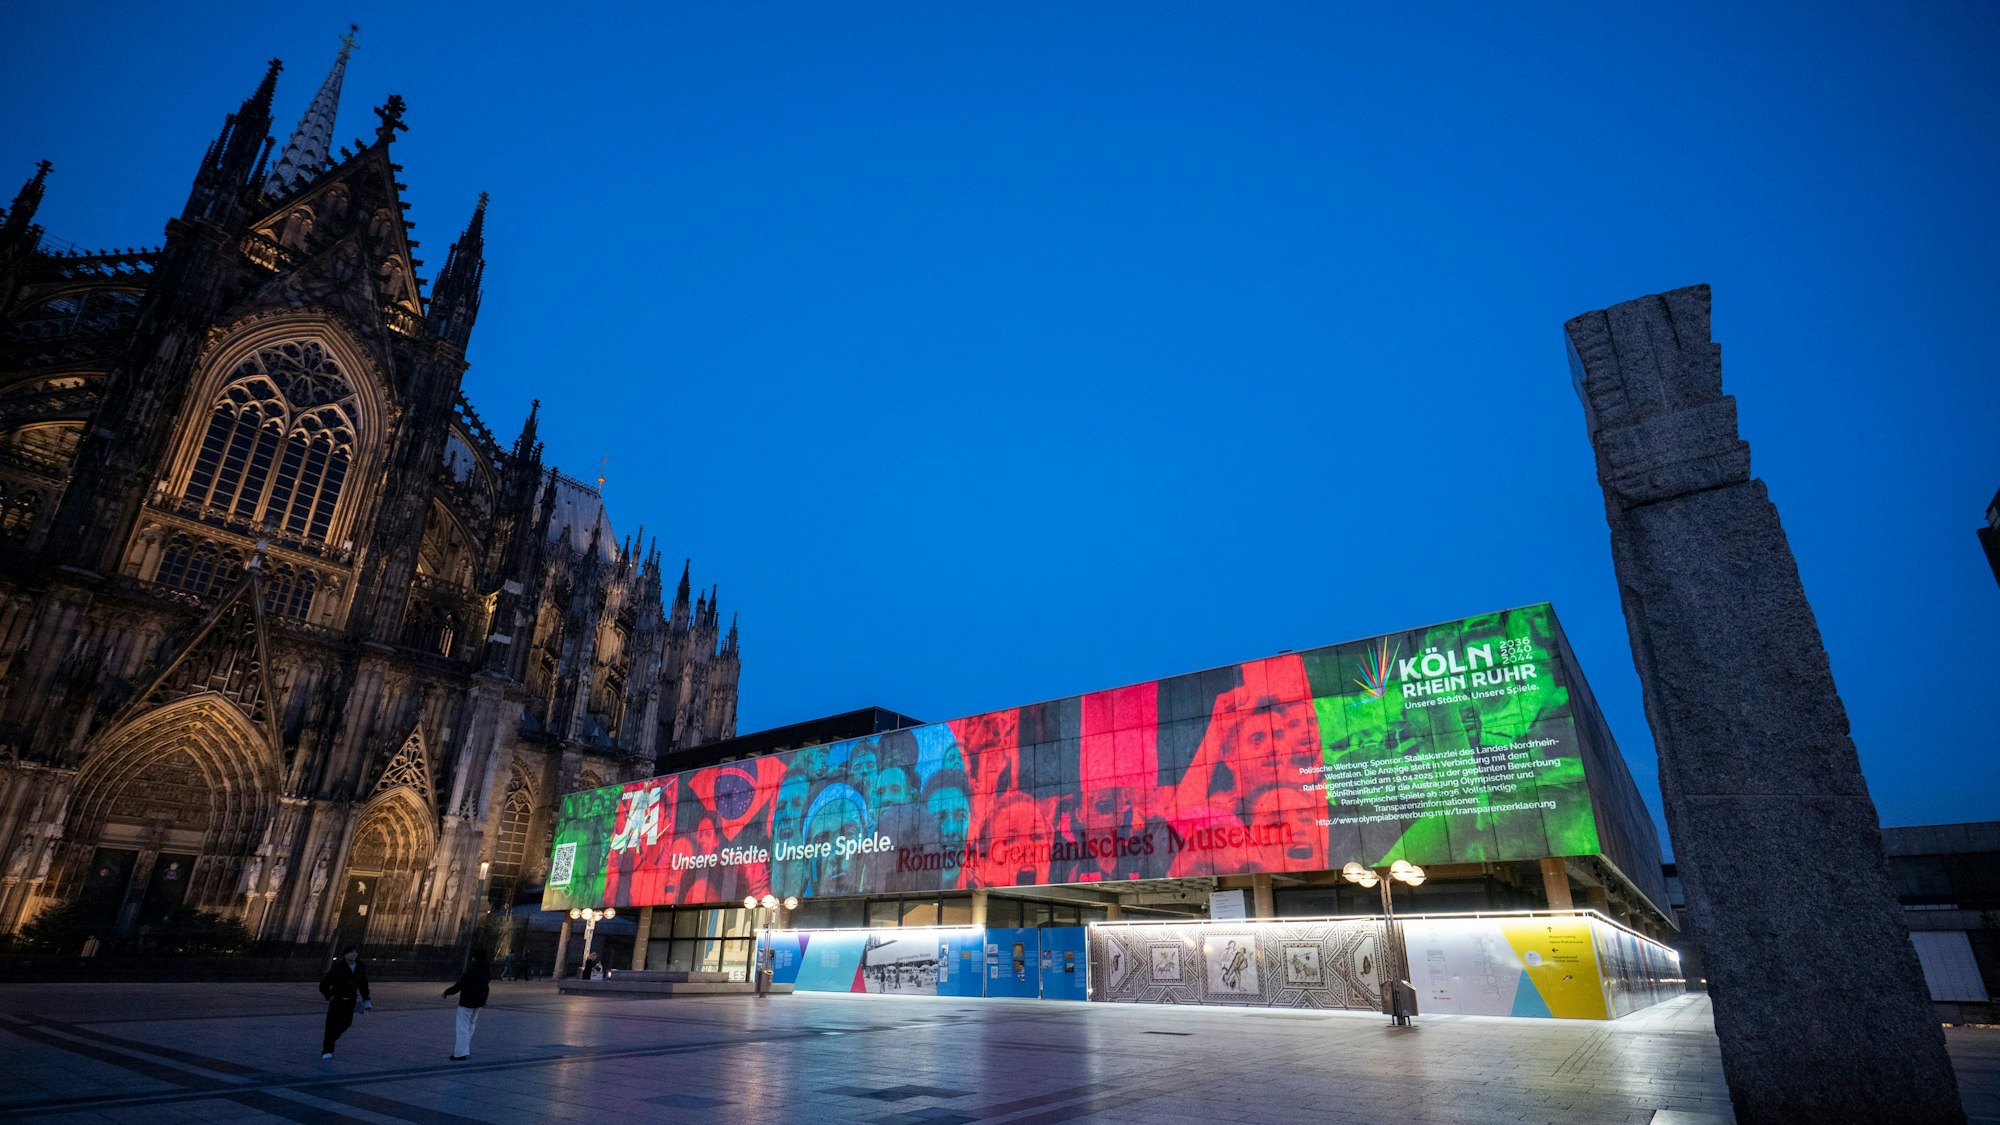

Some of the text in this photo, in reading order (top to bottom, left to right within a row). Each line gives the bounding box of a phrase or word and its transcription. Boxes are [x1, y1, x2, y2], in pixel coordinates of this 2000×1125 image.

[1500, 637, 1530, 649] 2036
[1501, 644, 1532, 656] 2040
[1399, 644, 1494, 682] KÖLN
[1502, 653, 1533, 664] 2044
[1402, 664, 1536, 698] RHEIN RUHR
[1404, 684, 1540, 709] Unsere Städte. Unsere Spiele.
[1300, 766, 1332, 775] Politische
[1333, 762, 1369, 771] Werbung:
[1404, 749, 1458, 762] Staatskanzlei
[1460, 748, 1474, 756] des
[1476, 744, 1508, 754] Landes
[1510, 738, 1560, 750] Nordrhein-
[1325, 771, 1362, 780] Westfalen.
[1378, 766, 1409, 776] Anzeige
[1410, 762, 1431, 770] steht
[1432, 760, 1440, 769] in
[1442, 754, 1490, 768] Verbindung
[1492, 752, 1506, 760] mit
[1508, 750, 1528, 760] dem
[1303, 778, 1377, 792] Ratsbürgerentscheid
[1446, 768, 1460, 777] der
[1462, 764, 1506, 776] geplanten
[1508, 758, 1560, 770] Bewerbung
[1385, 784, 1396, 792] für
[1398, 782, 1410, 790] die
[1412, 778, 1459, 790] Austragung
[1460, 772, 1514, 785] Olympischer
[1516, 770, 1534, 779] und
[1341, 794, 1398, 806] Paralympischer
[1400, 790, 1425, 801] Spiele
[1426, 790, 1438, 798] ab
[1462, 784, 1517, 794] Vollständige
[1374, 796, 1480, 812] Transparenzinformationen:
[672, 832, 895, 870] Unsere Städte. Unsere Spiele.
[1168, 822, 1295, 854] Museum
